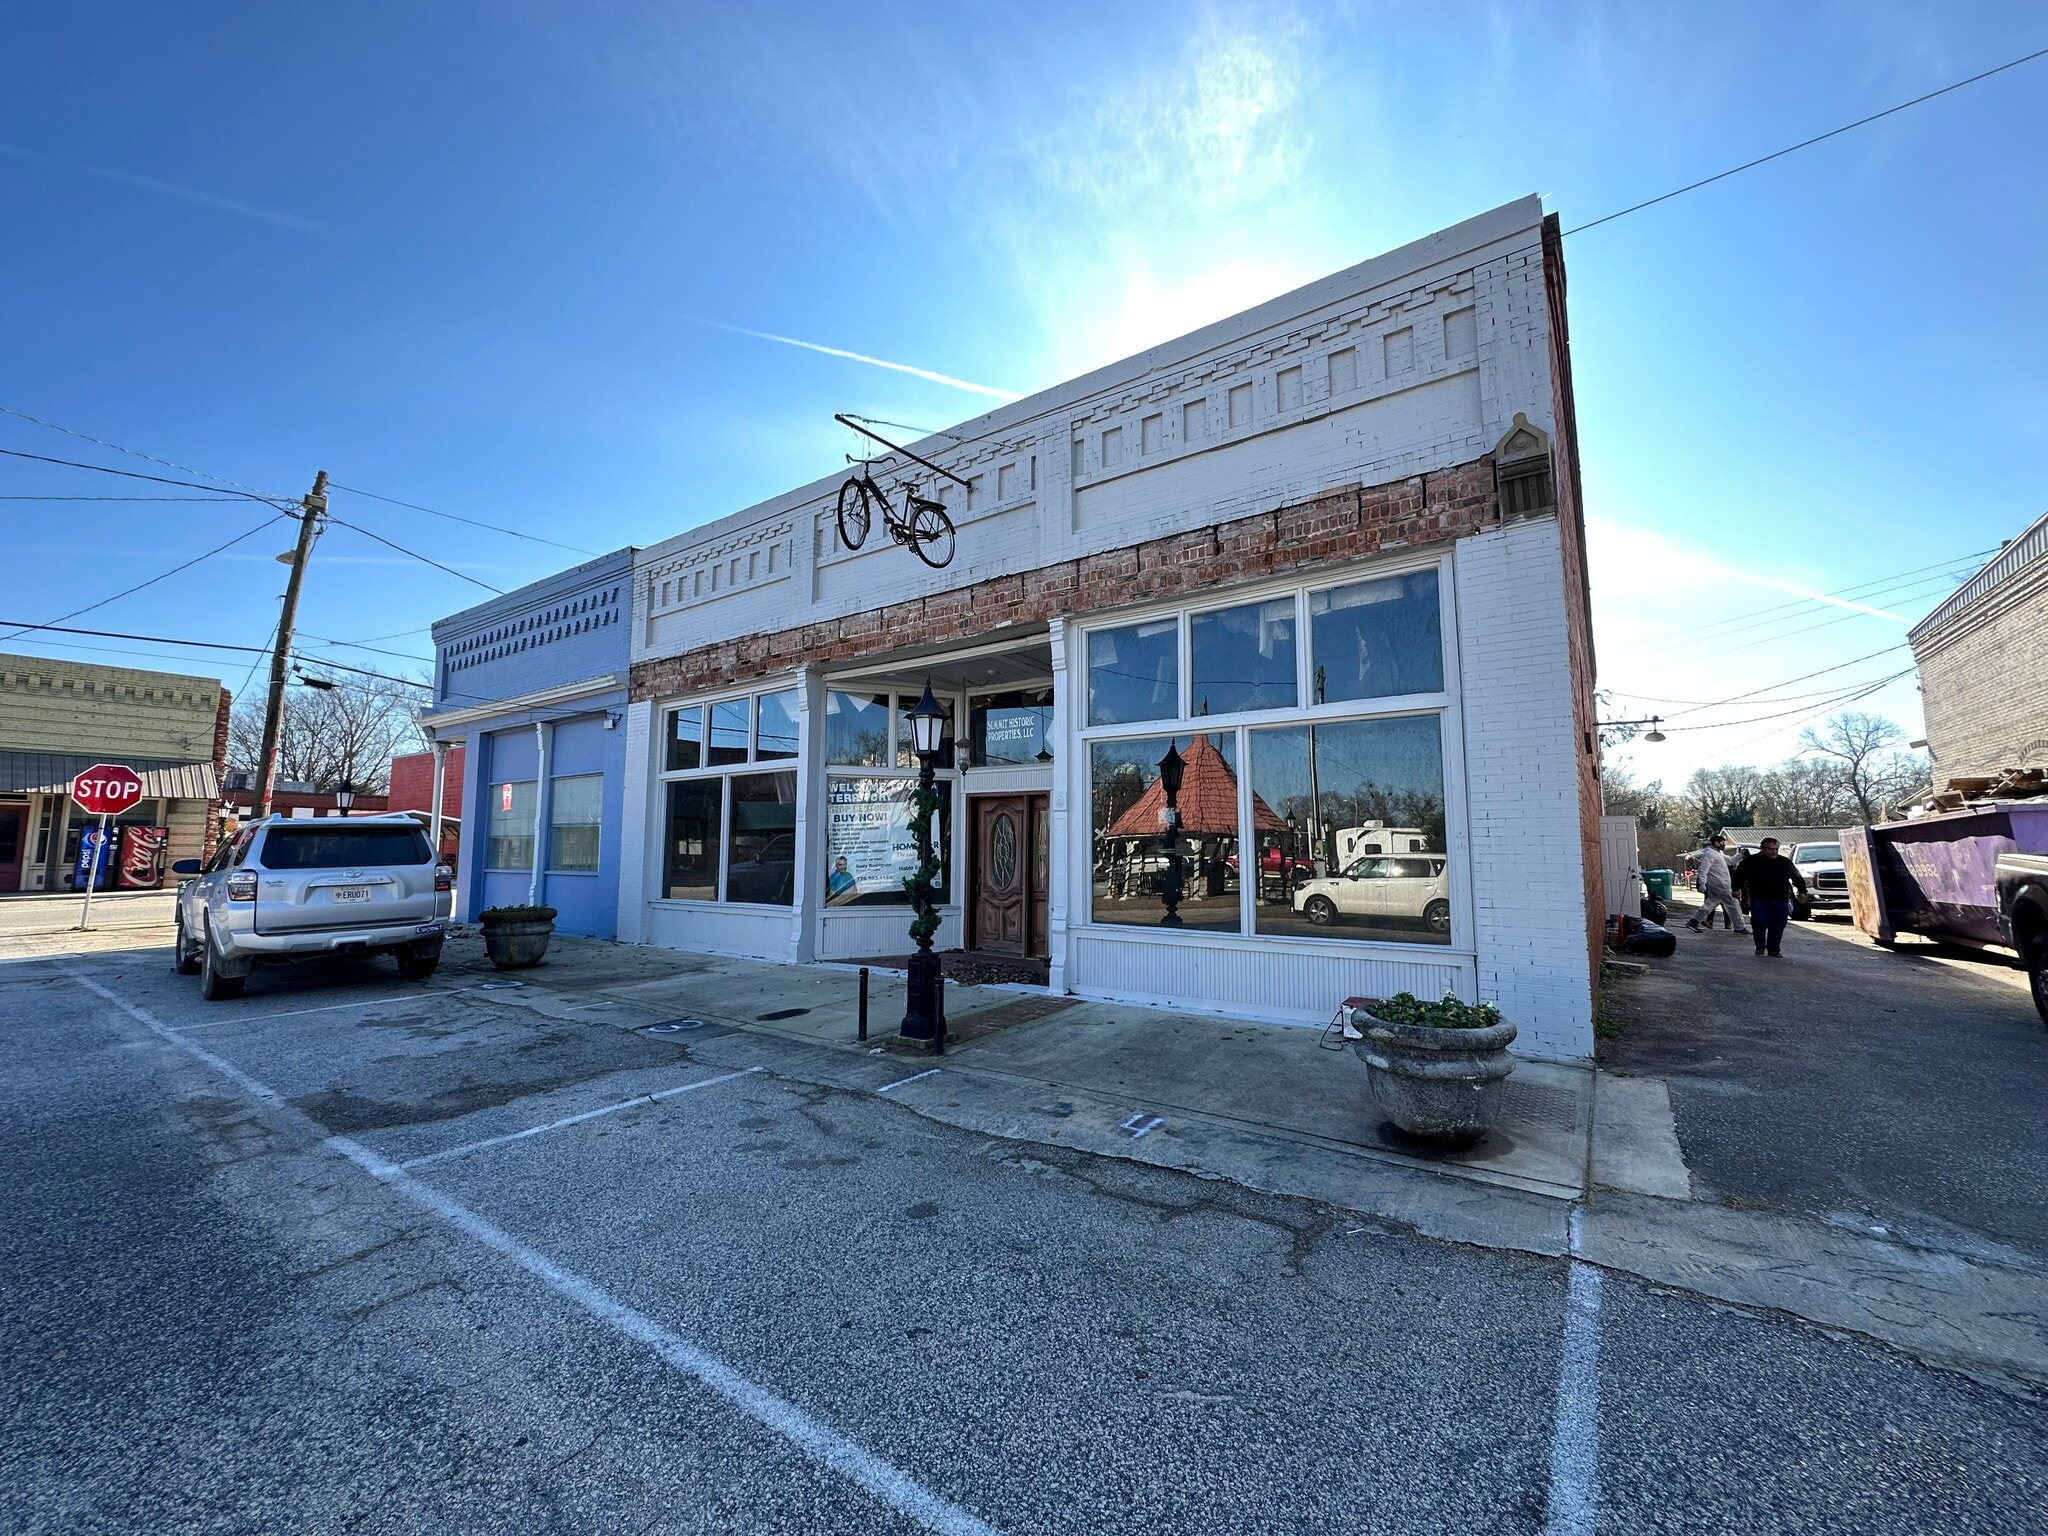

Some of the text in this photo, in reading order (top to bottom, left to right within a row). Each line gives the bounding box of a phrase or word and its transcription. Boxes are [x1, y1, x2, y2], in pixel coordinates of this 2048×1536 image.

[1008, 716, 1035, 728] HISTORIC
[987, 727, 1034, 741] PROPERTIES, LLC
[77, 779, 139, 800] STOP
[834, 813, 887, 822] BUY NOW!
[81, 849, 91, 868] pepsi
[343, 890, 369, 899] ERU071
[1119, 1114, 1163, 1139] 4
